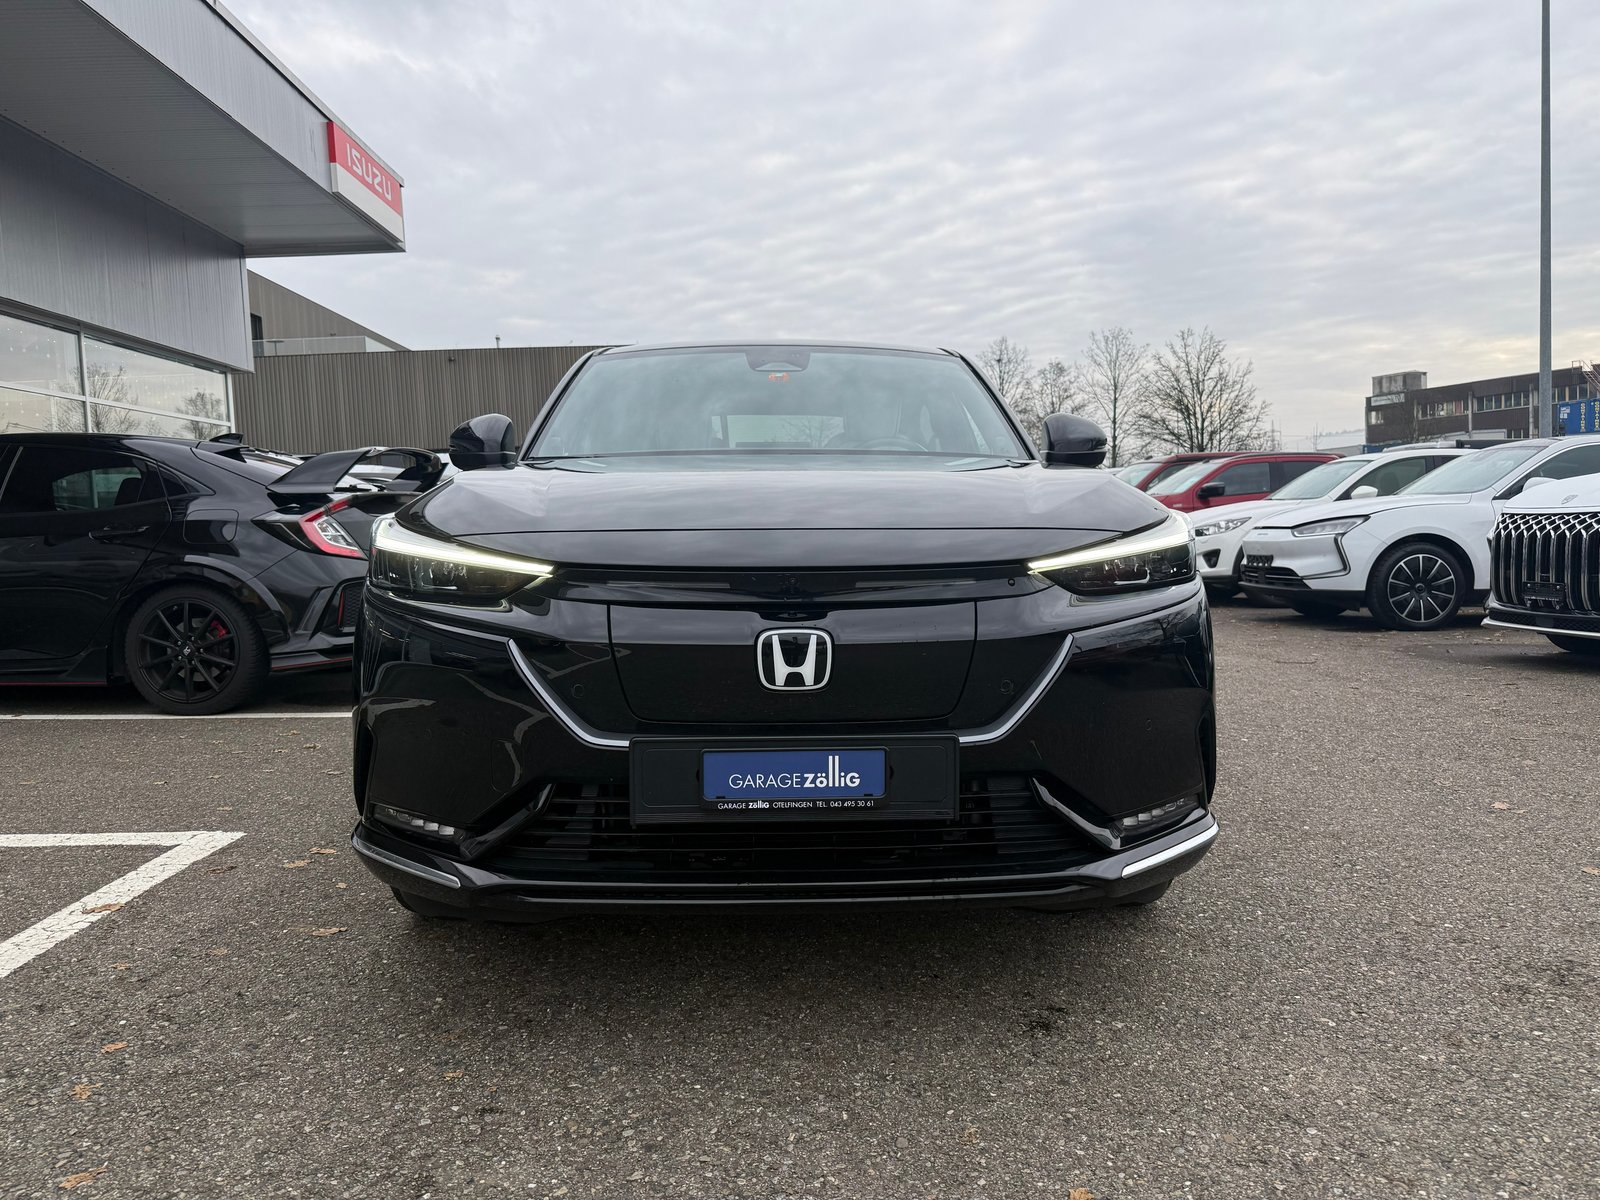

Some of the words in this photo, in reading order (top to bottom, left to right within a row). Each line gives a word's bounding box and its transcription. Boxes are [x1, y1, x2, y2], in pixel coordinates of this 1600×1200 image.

[346, 143, 392, 201] ISUZU
[729, 773, 801, 789] GARAGE
[717, 802, 747, 810] GARAGE
[772, 801, 813, 809] OTELFINGEN
[829, 800, 842, 808] 043
